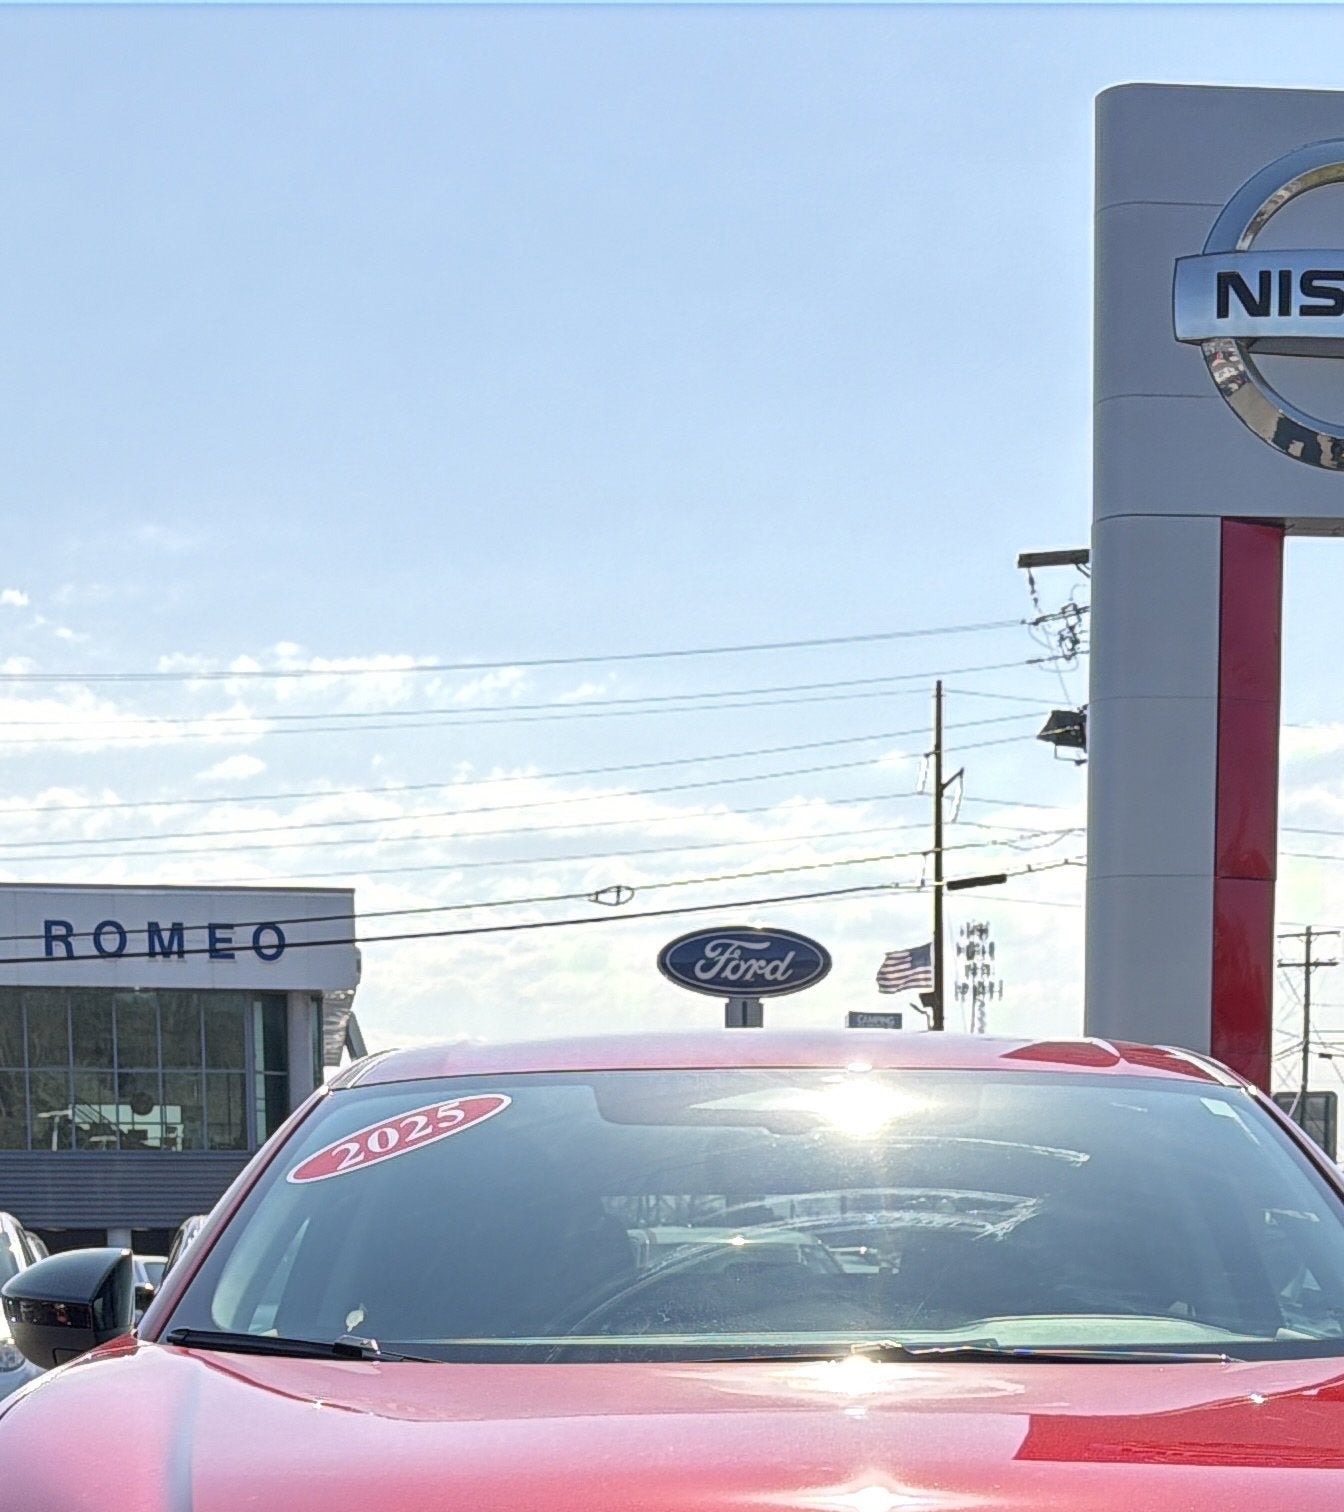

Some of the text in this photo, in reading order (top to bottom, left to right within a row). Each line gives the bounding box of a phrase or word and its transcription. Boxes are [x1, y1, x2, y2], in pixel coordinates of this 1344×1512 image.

[43, 919, 286, 962] ROMEO
[694, 938, 796, 981] Ford
[331, 1101, 465, 1171] 2025
